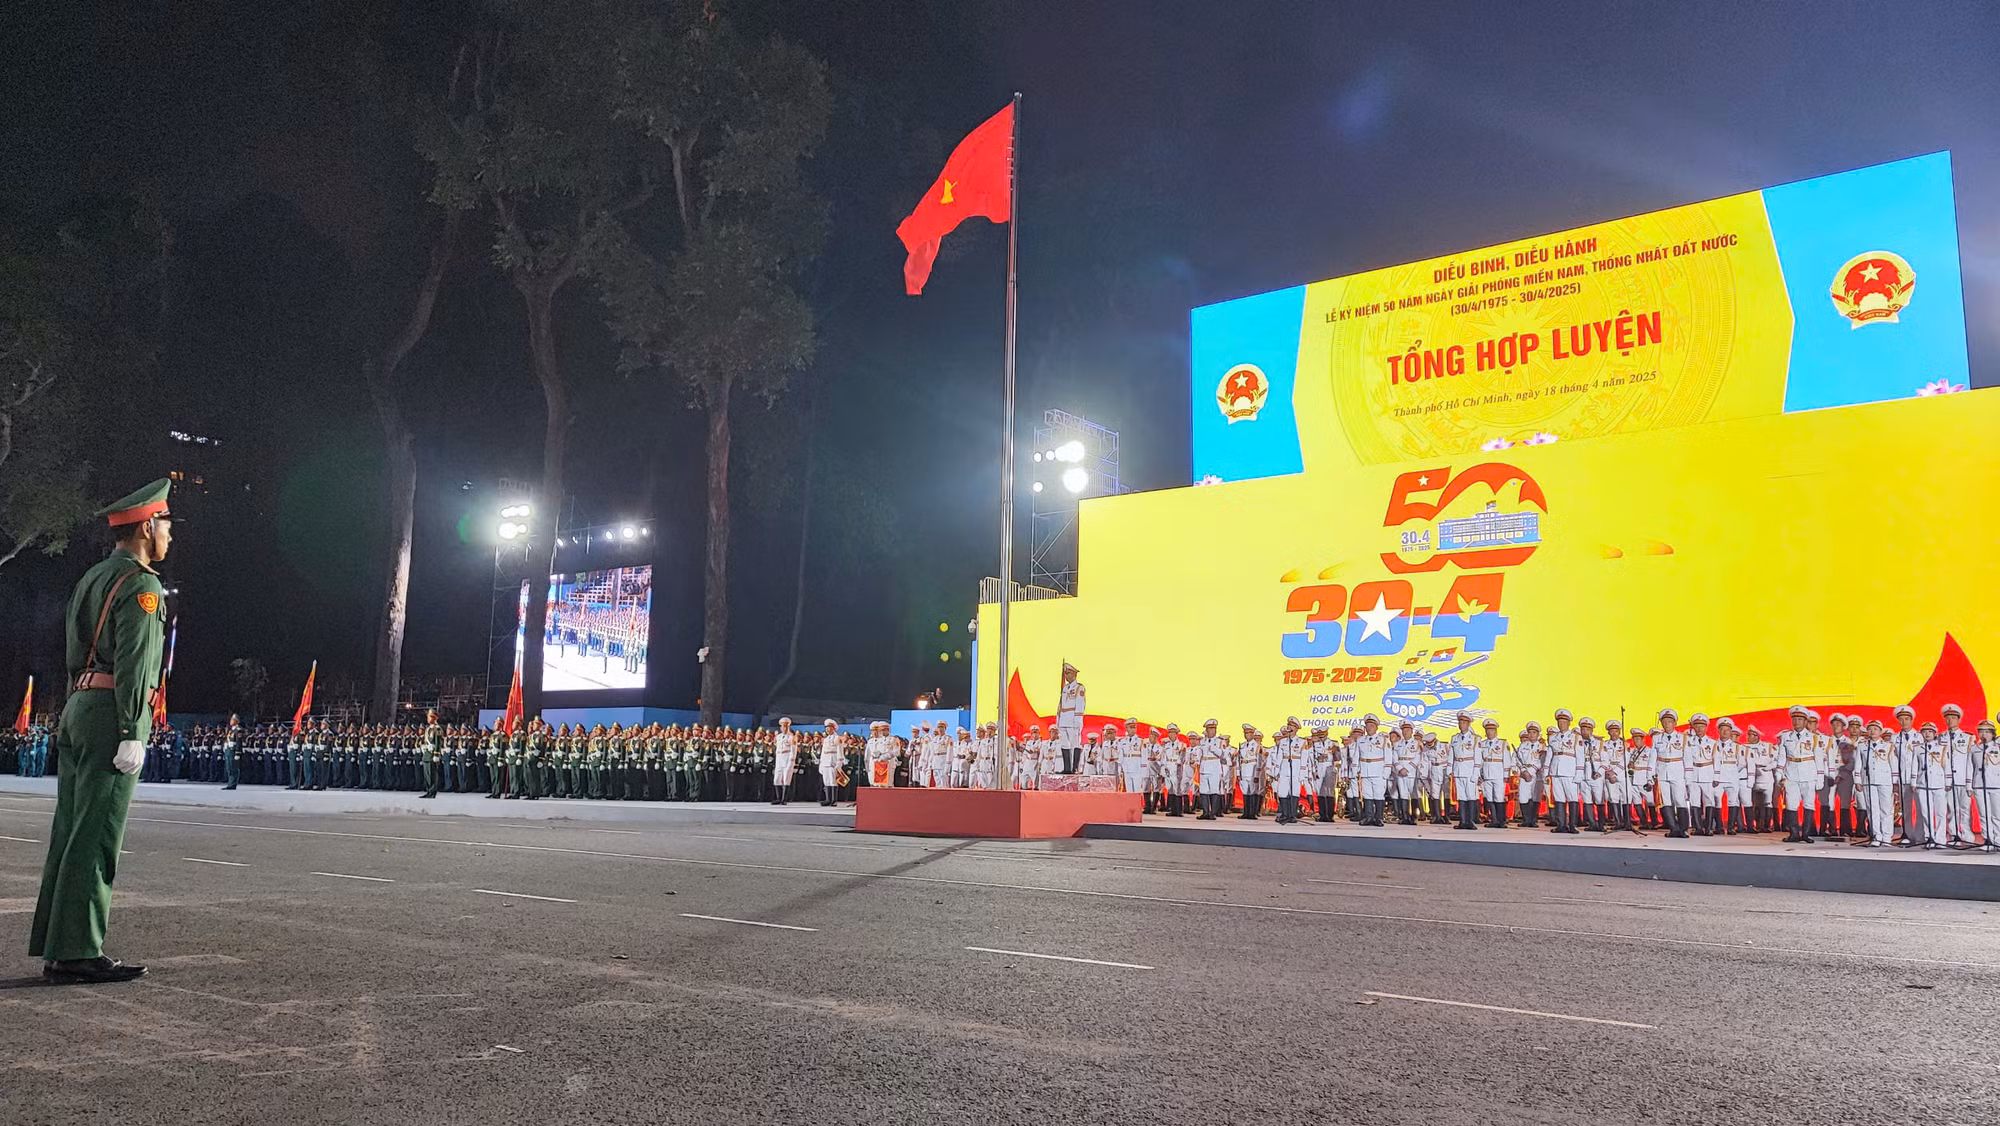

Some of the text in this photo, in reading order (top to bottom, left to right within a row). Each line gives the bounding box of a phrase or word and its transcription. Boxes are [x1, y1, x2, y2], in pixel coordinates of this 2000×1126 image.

[1355, 303, 1381, 318] NIỆM
[1383, 300, 1396, 312] 50
[1398, 295, 1423, 310] NĂM
[1425, 288, 1454, 304] NGÀY
[1457, 282, 1478, 299] GIẢI
[1482, 277, 1520, 294] PHÓNG
[1592, 253, 1632, 273] THỐNG
[1636, 243, 1669, 264] NHẤT
[1672, 239, 1698, 257] ĐẤT
[1701, 234, 1738, 252] NƯỚC
[1434, 238, 1597, 284] DIỄU BINH, DIỄU HÀNH
[1451, 295, 1508, 316] (30/4/1975
[1519, 281, 1581, 304] 30/4/2025)
[1387, 309, 1662, 385] TỔNG HỢP LUYỆN
[1393, 370, 1657, 417] Thành phố Hồ Chí Minh, ngày 18 tháng 4 năm 2025
[1401, 530, 1430, 545] 30.4
